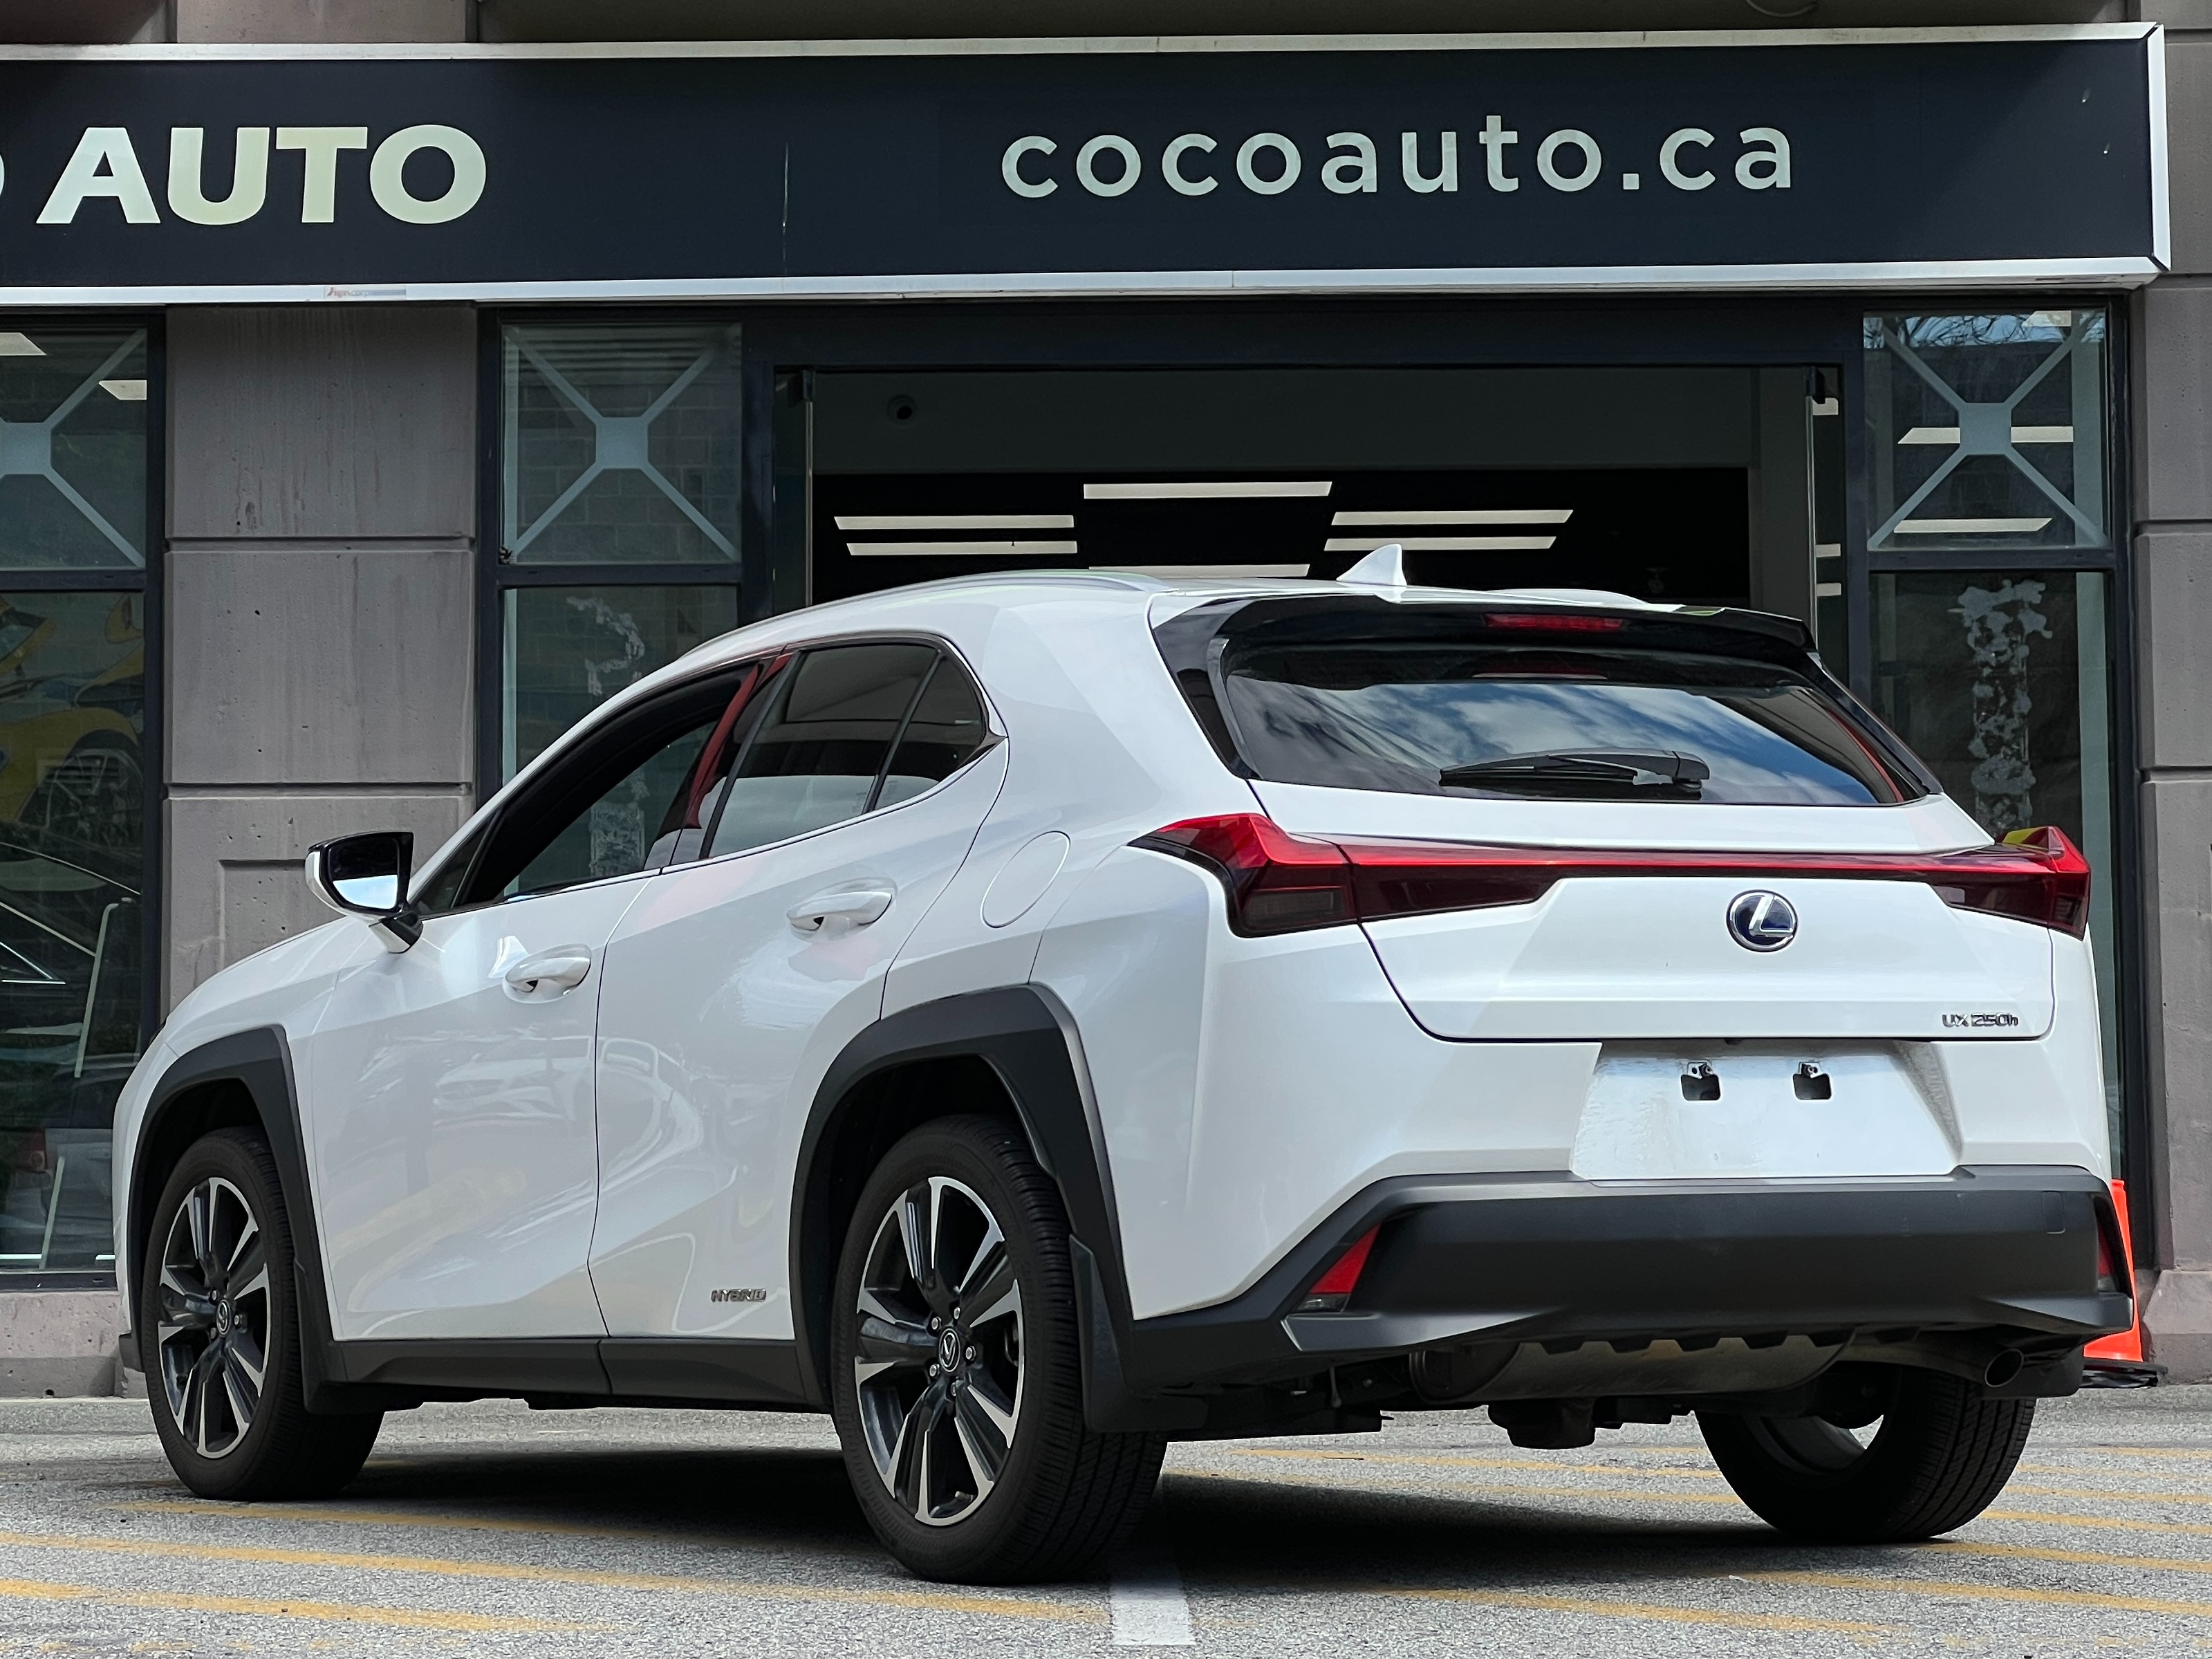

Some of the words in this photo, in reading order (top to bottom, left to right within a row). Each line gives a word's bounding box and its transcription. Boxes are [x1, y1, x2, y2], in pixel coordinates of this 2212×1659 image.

[36, 124, 487, 225] AUTO
[1001, 115, 1792, 198] cocoauto.ca
[1942, 1014, 1969, 1028] UX
[1971, 1013, 2019, 1028] 250h
[710, 1288, 767, 1303] HYBRID
